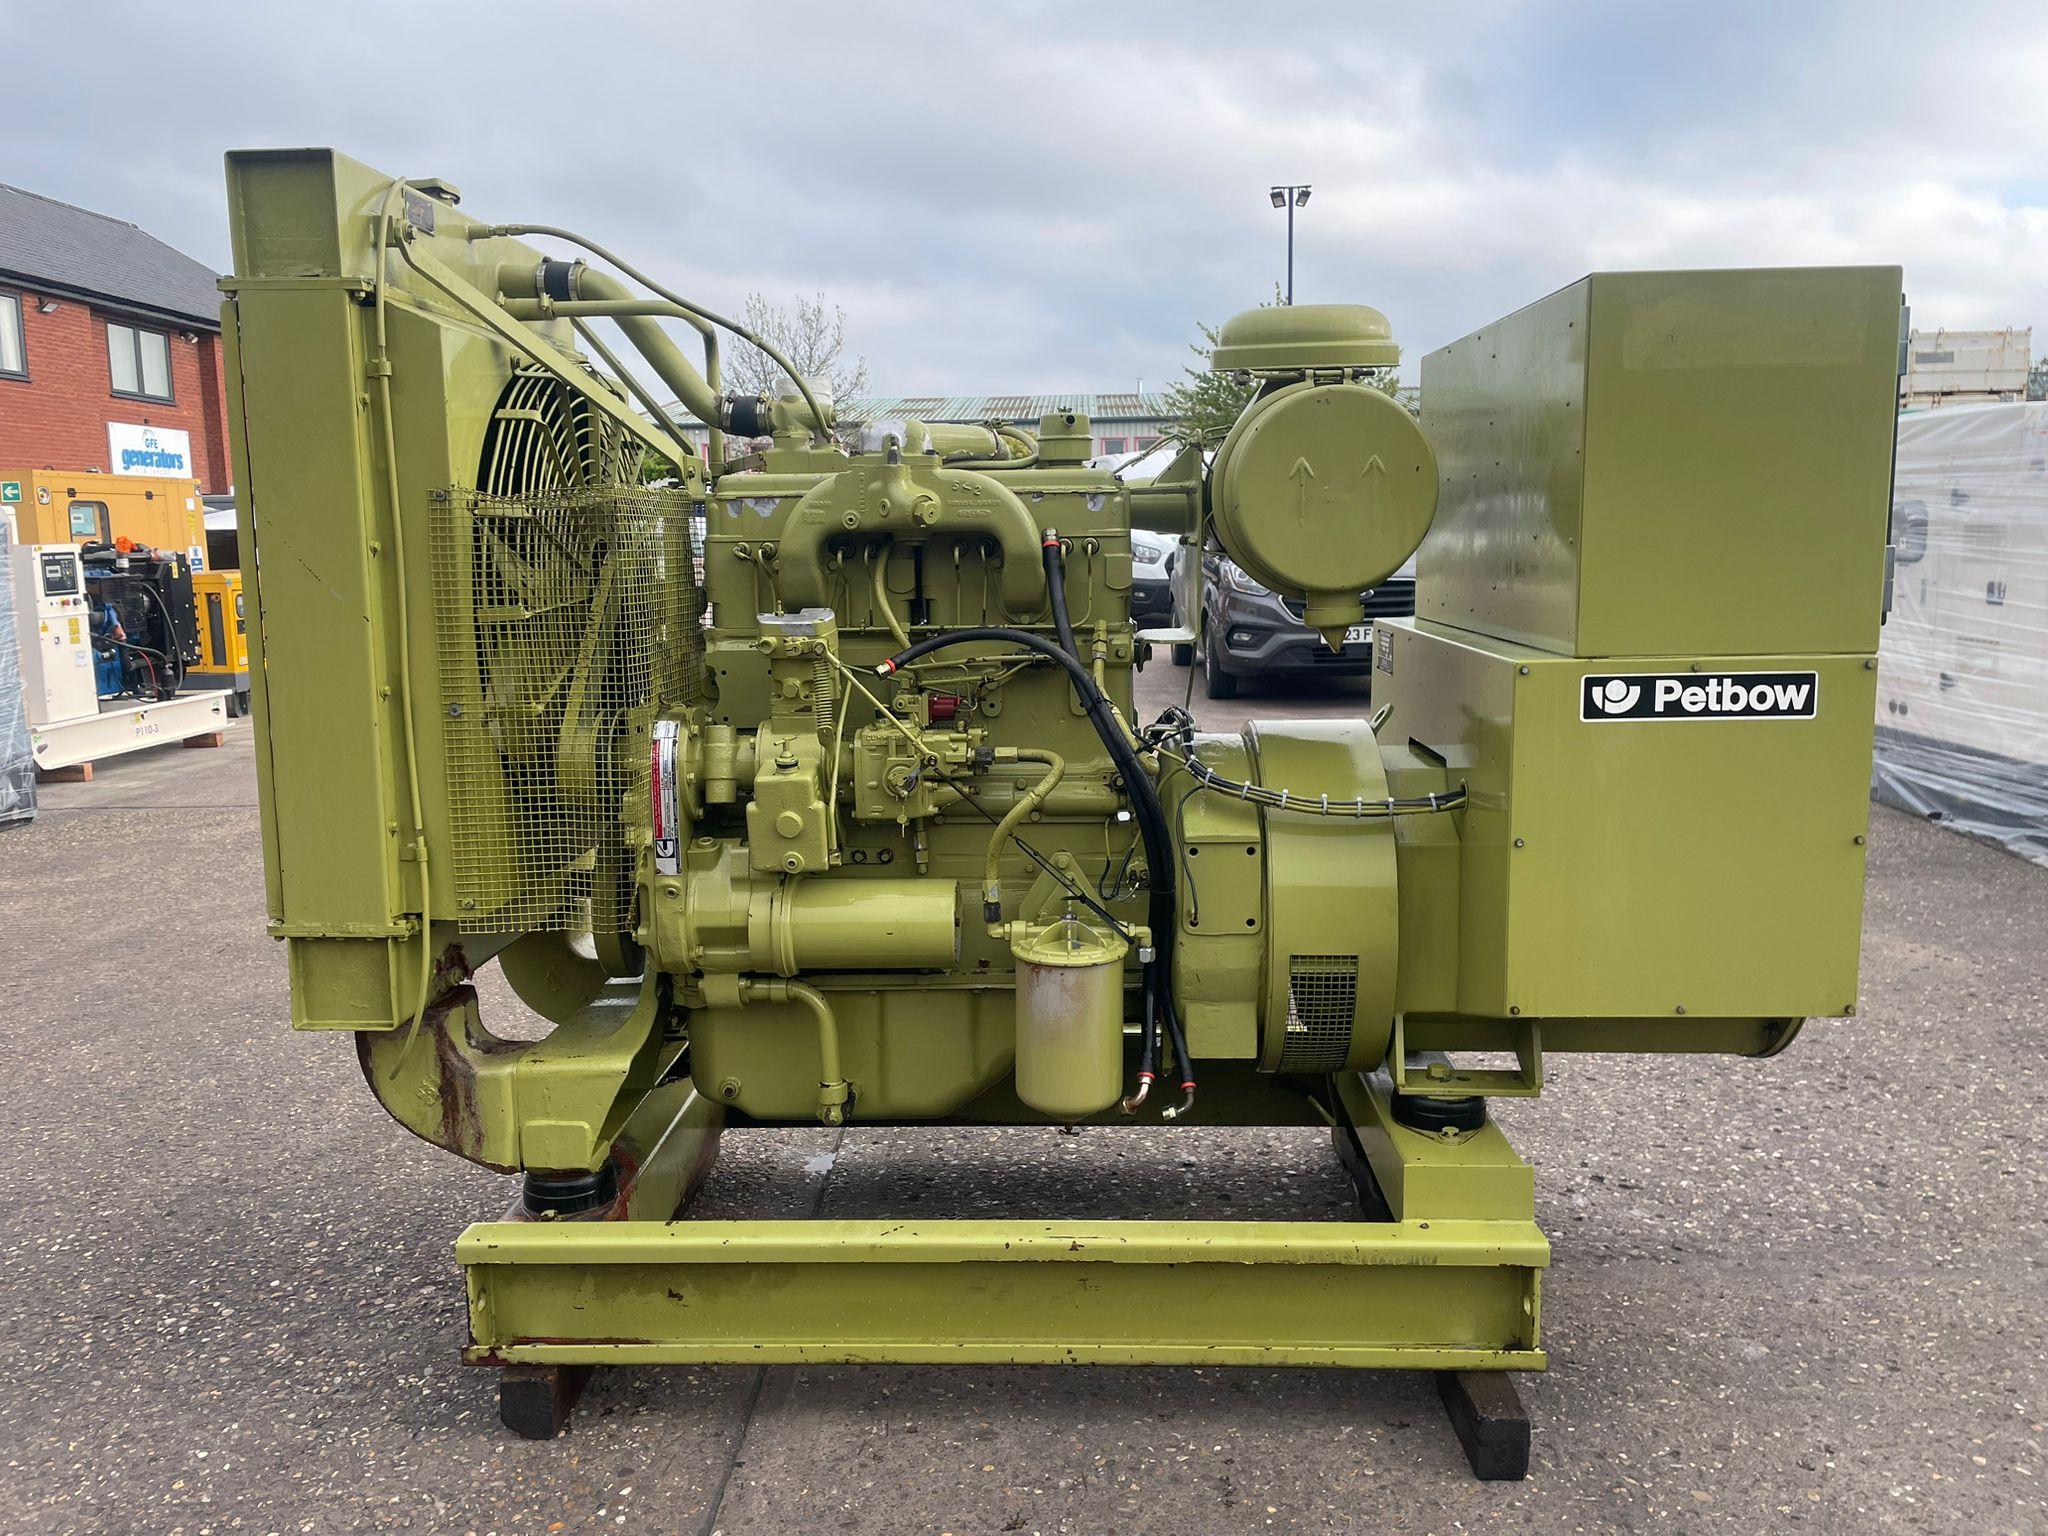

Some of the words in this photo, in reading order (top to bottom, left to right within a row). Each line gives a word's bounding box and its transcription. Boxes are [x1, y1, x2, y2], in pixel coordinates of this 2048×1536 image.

[145, 438, 158, 449] GFE
[122, 449, 184, 470] generators
[1654, 678, 1810, 713] Petbow
